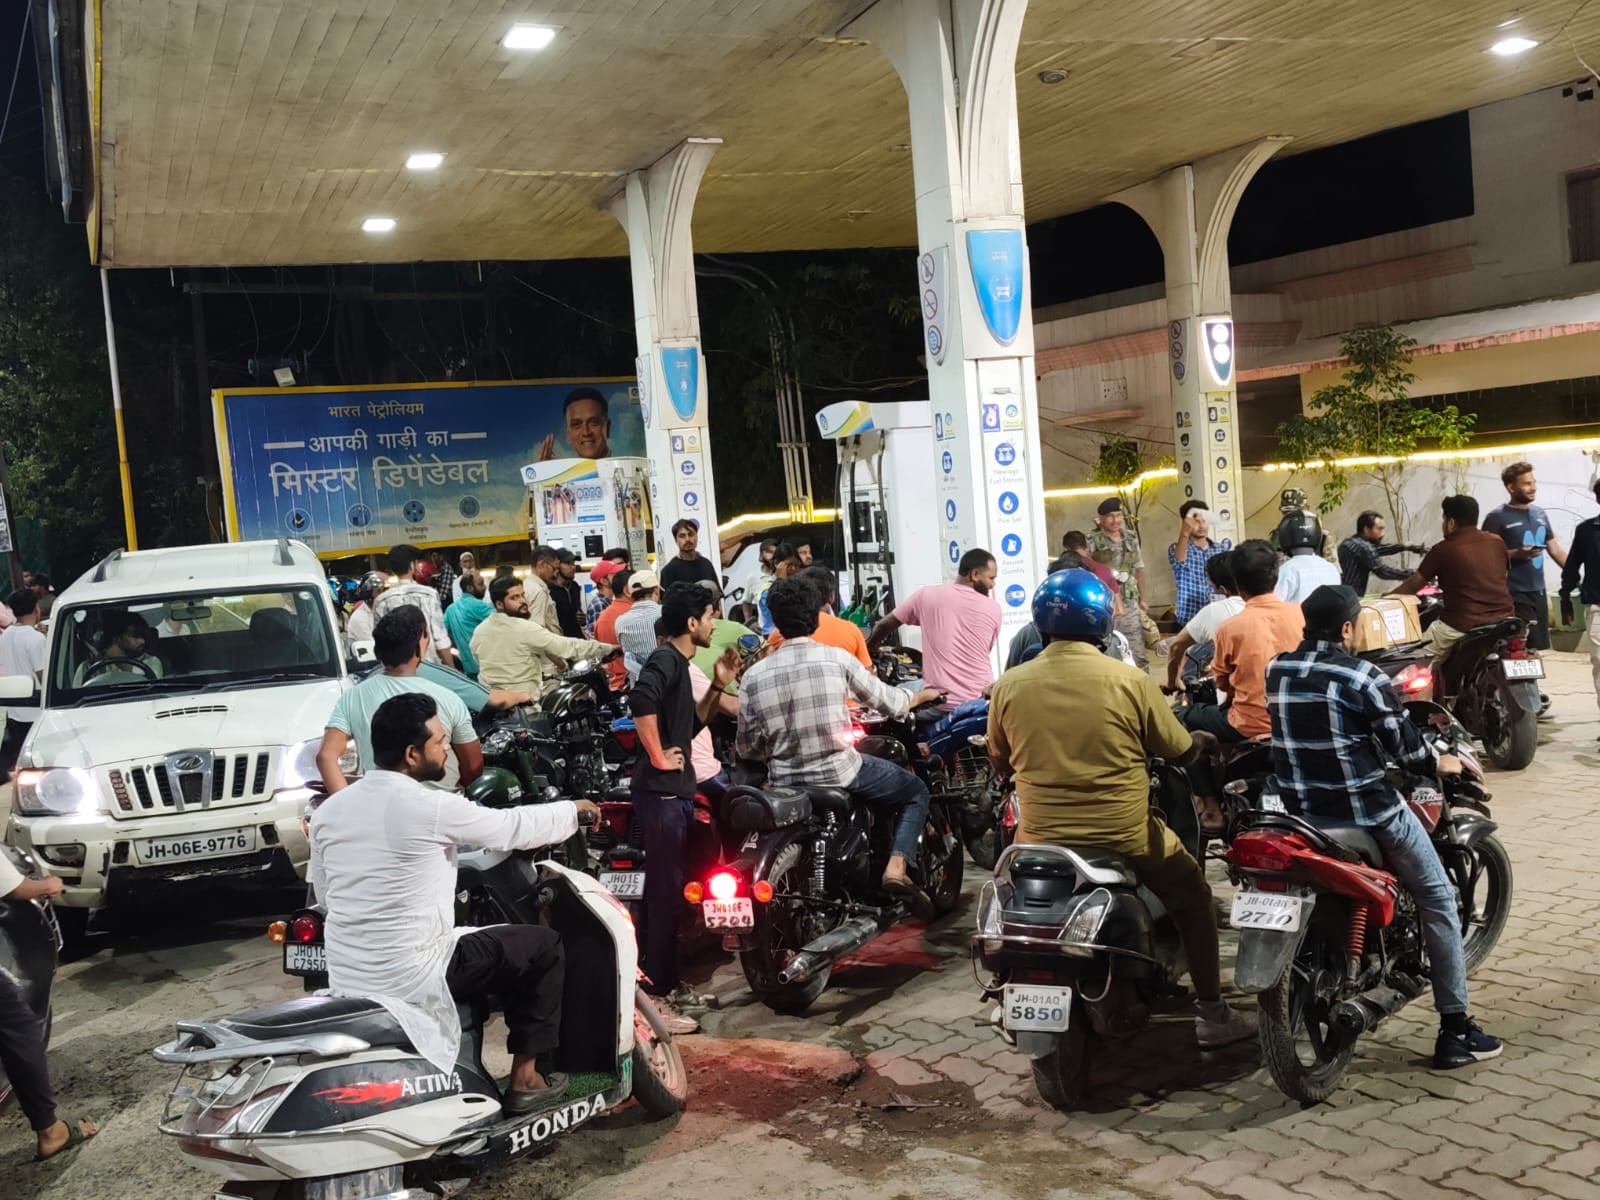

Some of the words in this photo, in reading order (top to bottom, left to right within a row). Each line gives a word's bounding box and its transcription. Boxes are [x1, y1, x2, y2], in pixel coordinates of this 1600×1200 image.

[328, 404, 361, 418] भारत
[367, 400, 425, 419] पेट्रोलियम
[308, 428, 368, 453] आपकी
[376, 426, 417, 450] गाड़ी
[425, 430, 448, 447] का
[268, 461, 358, 497] मिस्टर
[372, 453, 489, 490] डिपेंडेबल
[144, 834, 247, 860] JH-06E-9776
[607, 873, 641, 884] JH01E
[1015, 994, 1061, 1006] JH-01AQ
[1011, 1006, 1063, 1021] 5850
[509, 1093, 607, 1154] HONDA
